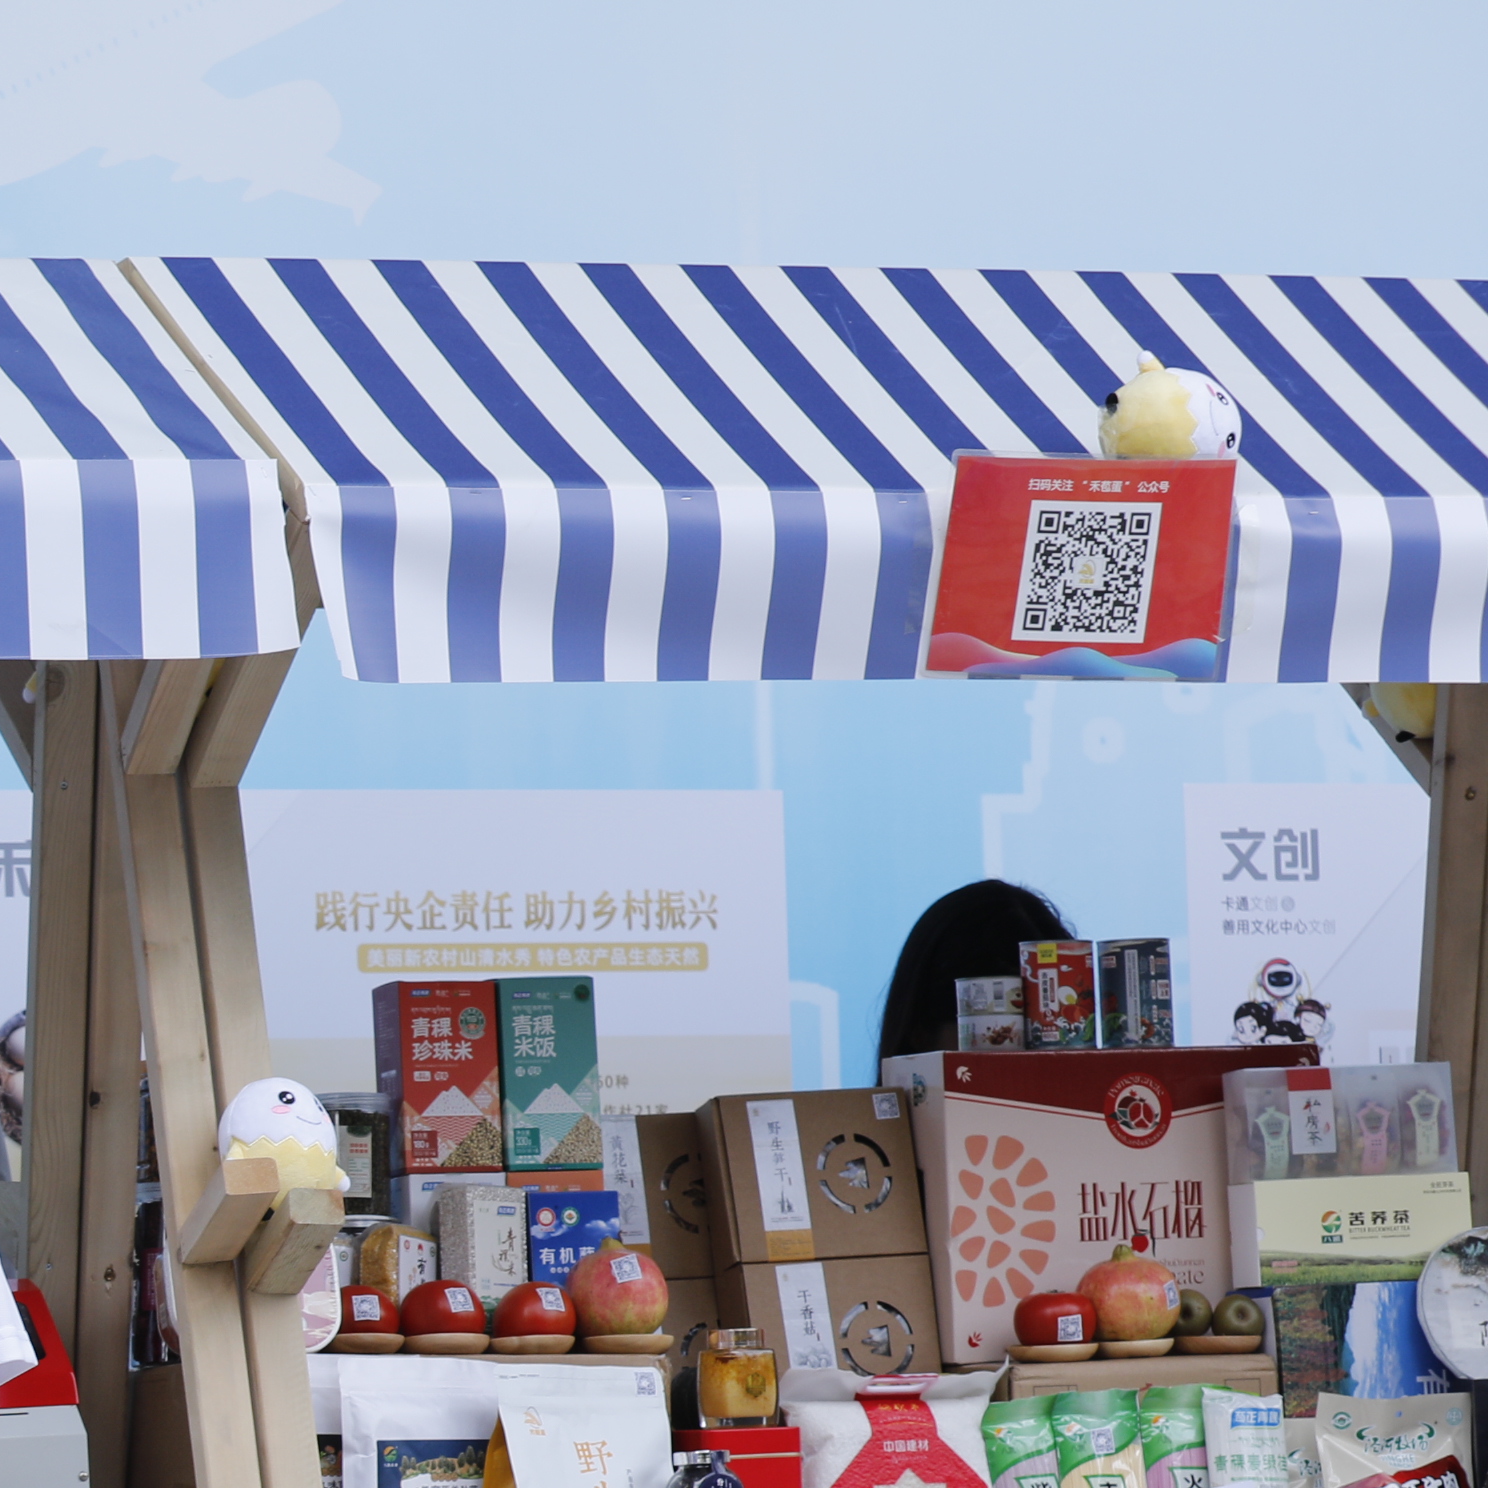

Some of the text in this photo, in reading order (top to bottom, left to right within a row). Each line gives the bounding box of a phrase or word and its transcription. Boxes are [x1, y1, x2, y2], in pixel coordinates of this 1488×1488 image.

[1027, 478, 1075, 492] 扫码关注
[1137, 481, 1170, 494] 公众号
[1220, 828, 1321, 881] 文创
[314, 889, 719, 932] 践行央企责任 助力乡村振兴
[366, 946, 700, 968] 美丽新农村山清水秀 特色农产品生态天然
[411, 1017, 453, 1038] 青稞
[512, 1015, 557, 1037] 青稞
[412, 1040, 474, 1061] 珍珠米
[514, 1037, 557, 1058] 米饭
[1348, 1210, 1410, 1226] 苦荞茶
[796, 1288, 817, 1336] 干香菇
